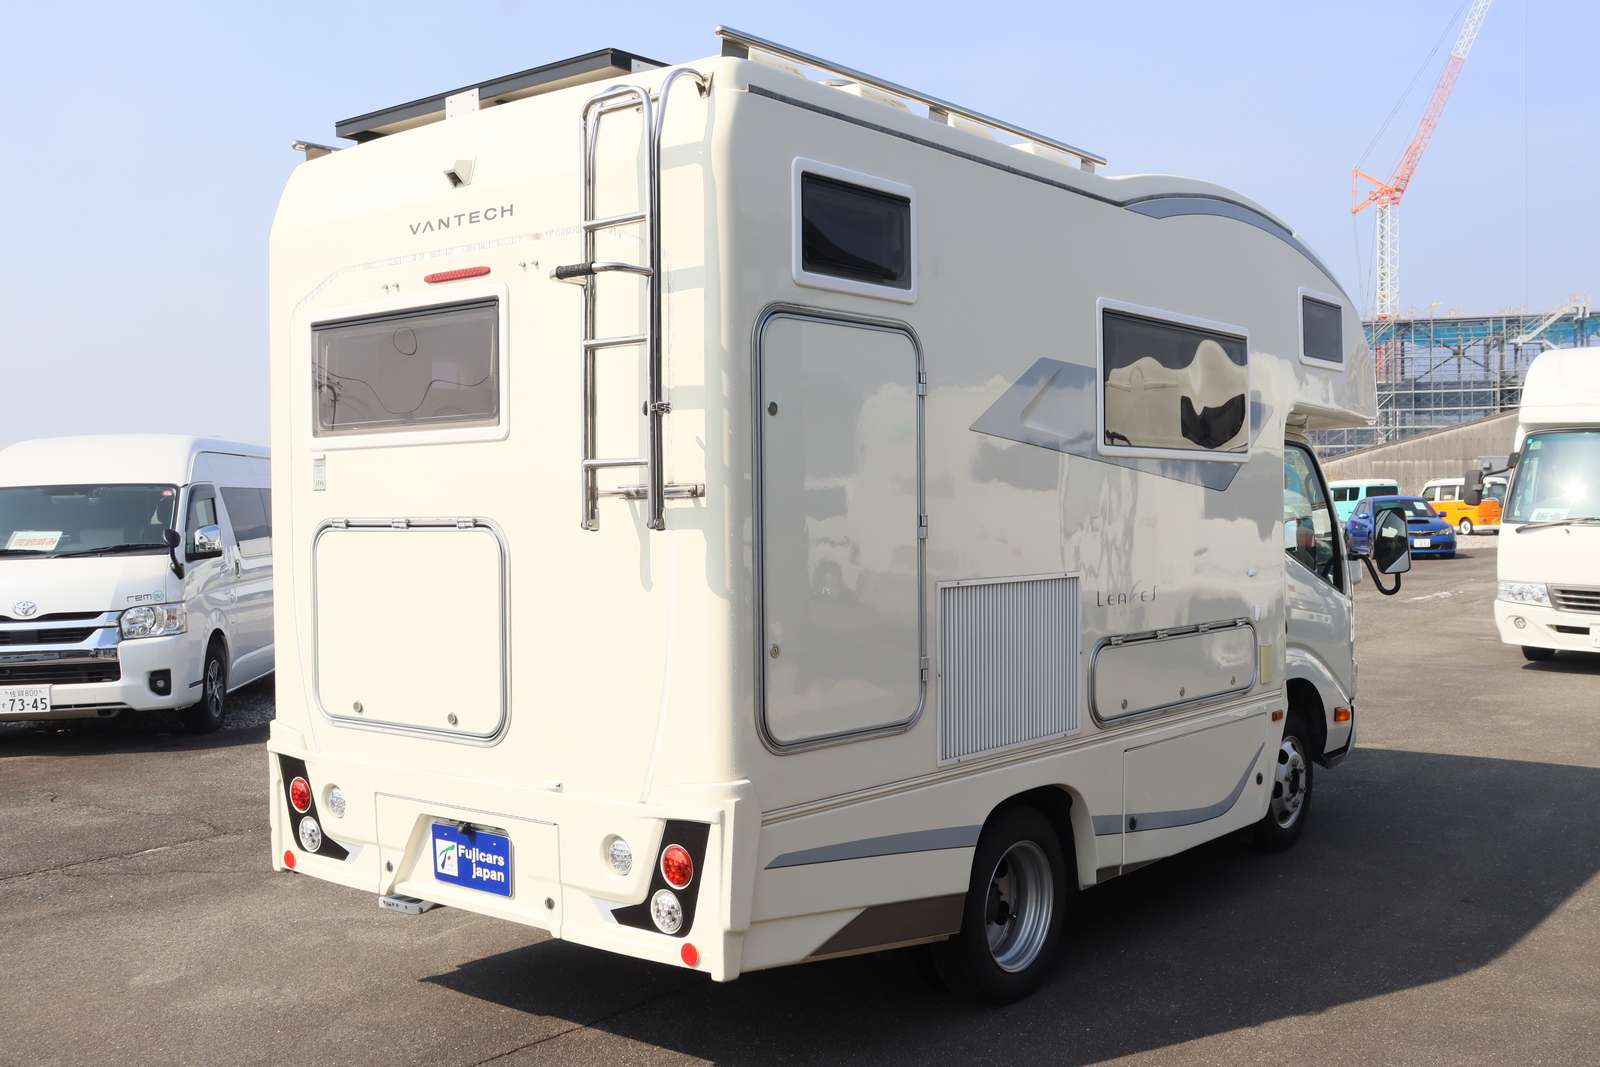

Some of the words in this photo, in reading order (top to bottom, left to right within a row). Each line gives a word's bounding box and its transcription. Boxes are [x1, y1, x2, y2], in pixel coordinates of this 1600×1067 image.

[409, 203, 514, 235] VANTECH
[9, 697, 47, 711] 73-45
[458, 844, 505, 866] Fujicars
[472, 863, 504, 882] japan
